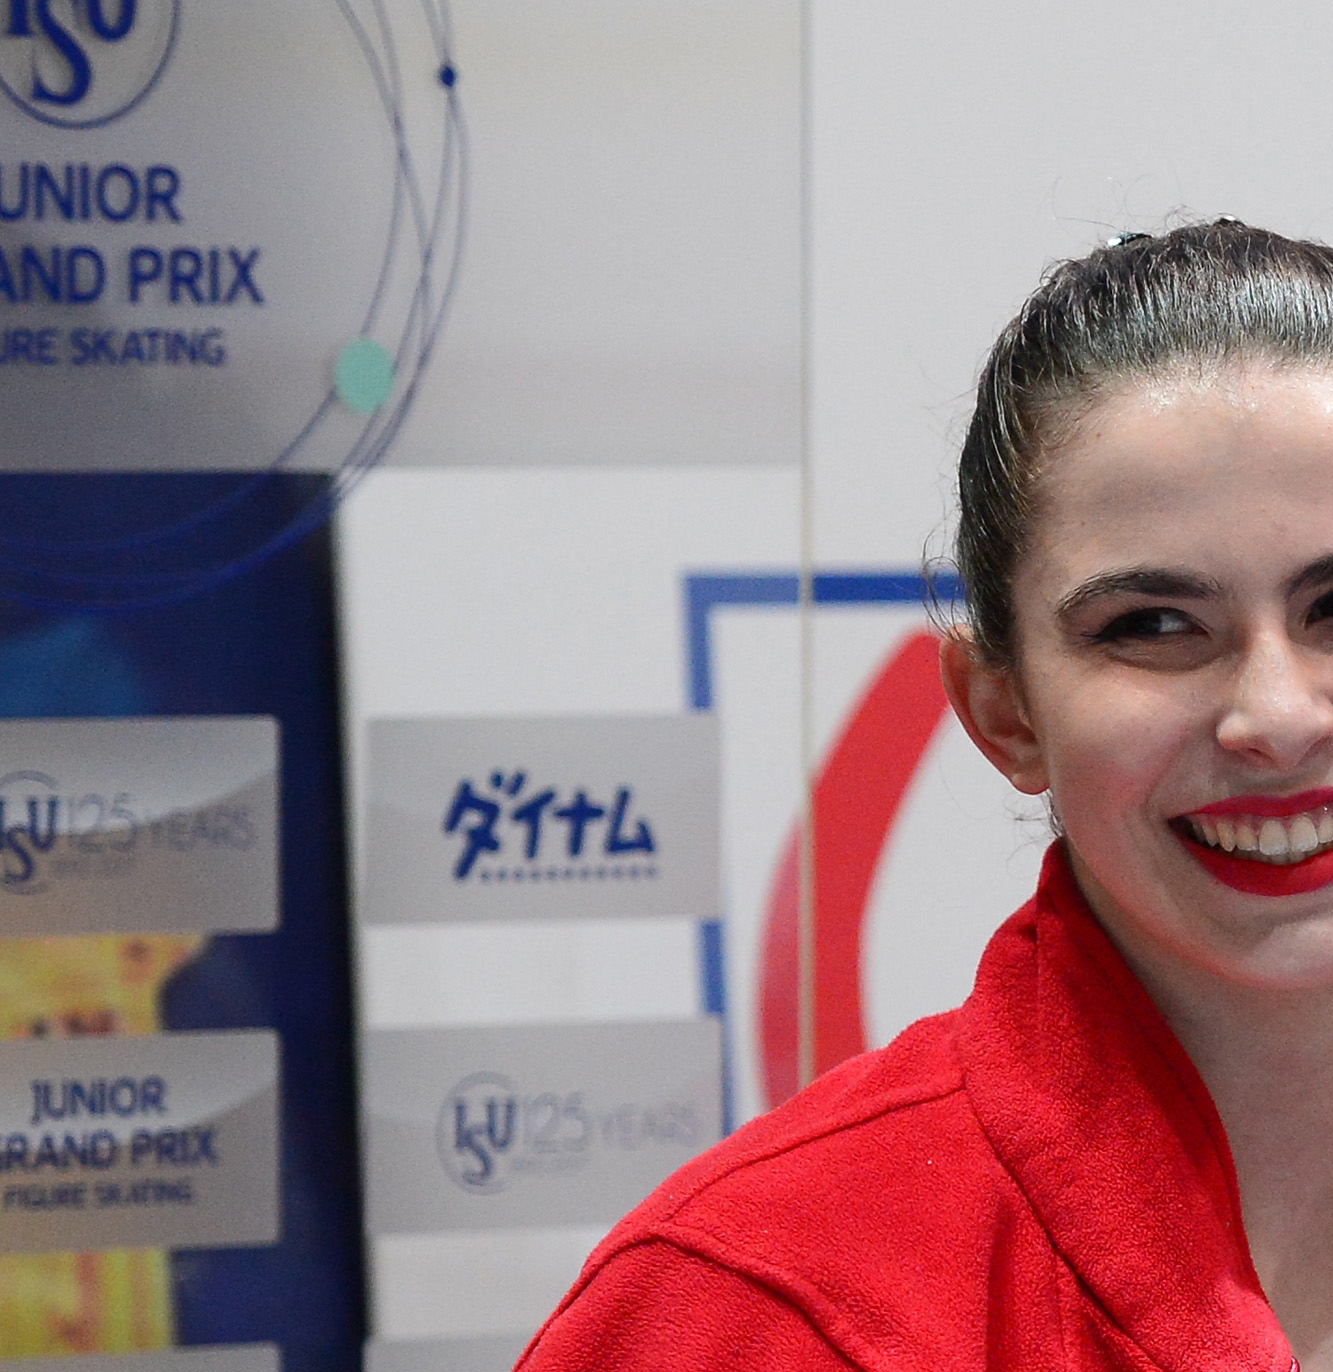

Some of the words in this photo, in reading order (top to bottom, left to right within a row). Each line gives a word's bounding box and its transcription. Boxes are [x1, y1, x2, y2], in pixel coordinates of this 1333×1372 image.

[0, 162, 184, 224] UNIOR
[0, 245, 106, 305] AND
[130, 246, 265, 305] PRIX
[70, 325, 227, 366] SKATING
[443, 770, 656, 881] ダイナム
[32, 1074, 167, 1125] JUNIOR
[0, 1130, 117, 1170] RAND
[130, 1127, 218, 1166] PRIX
